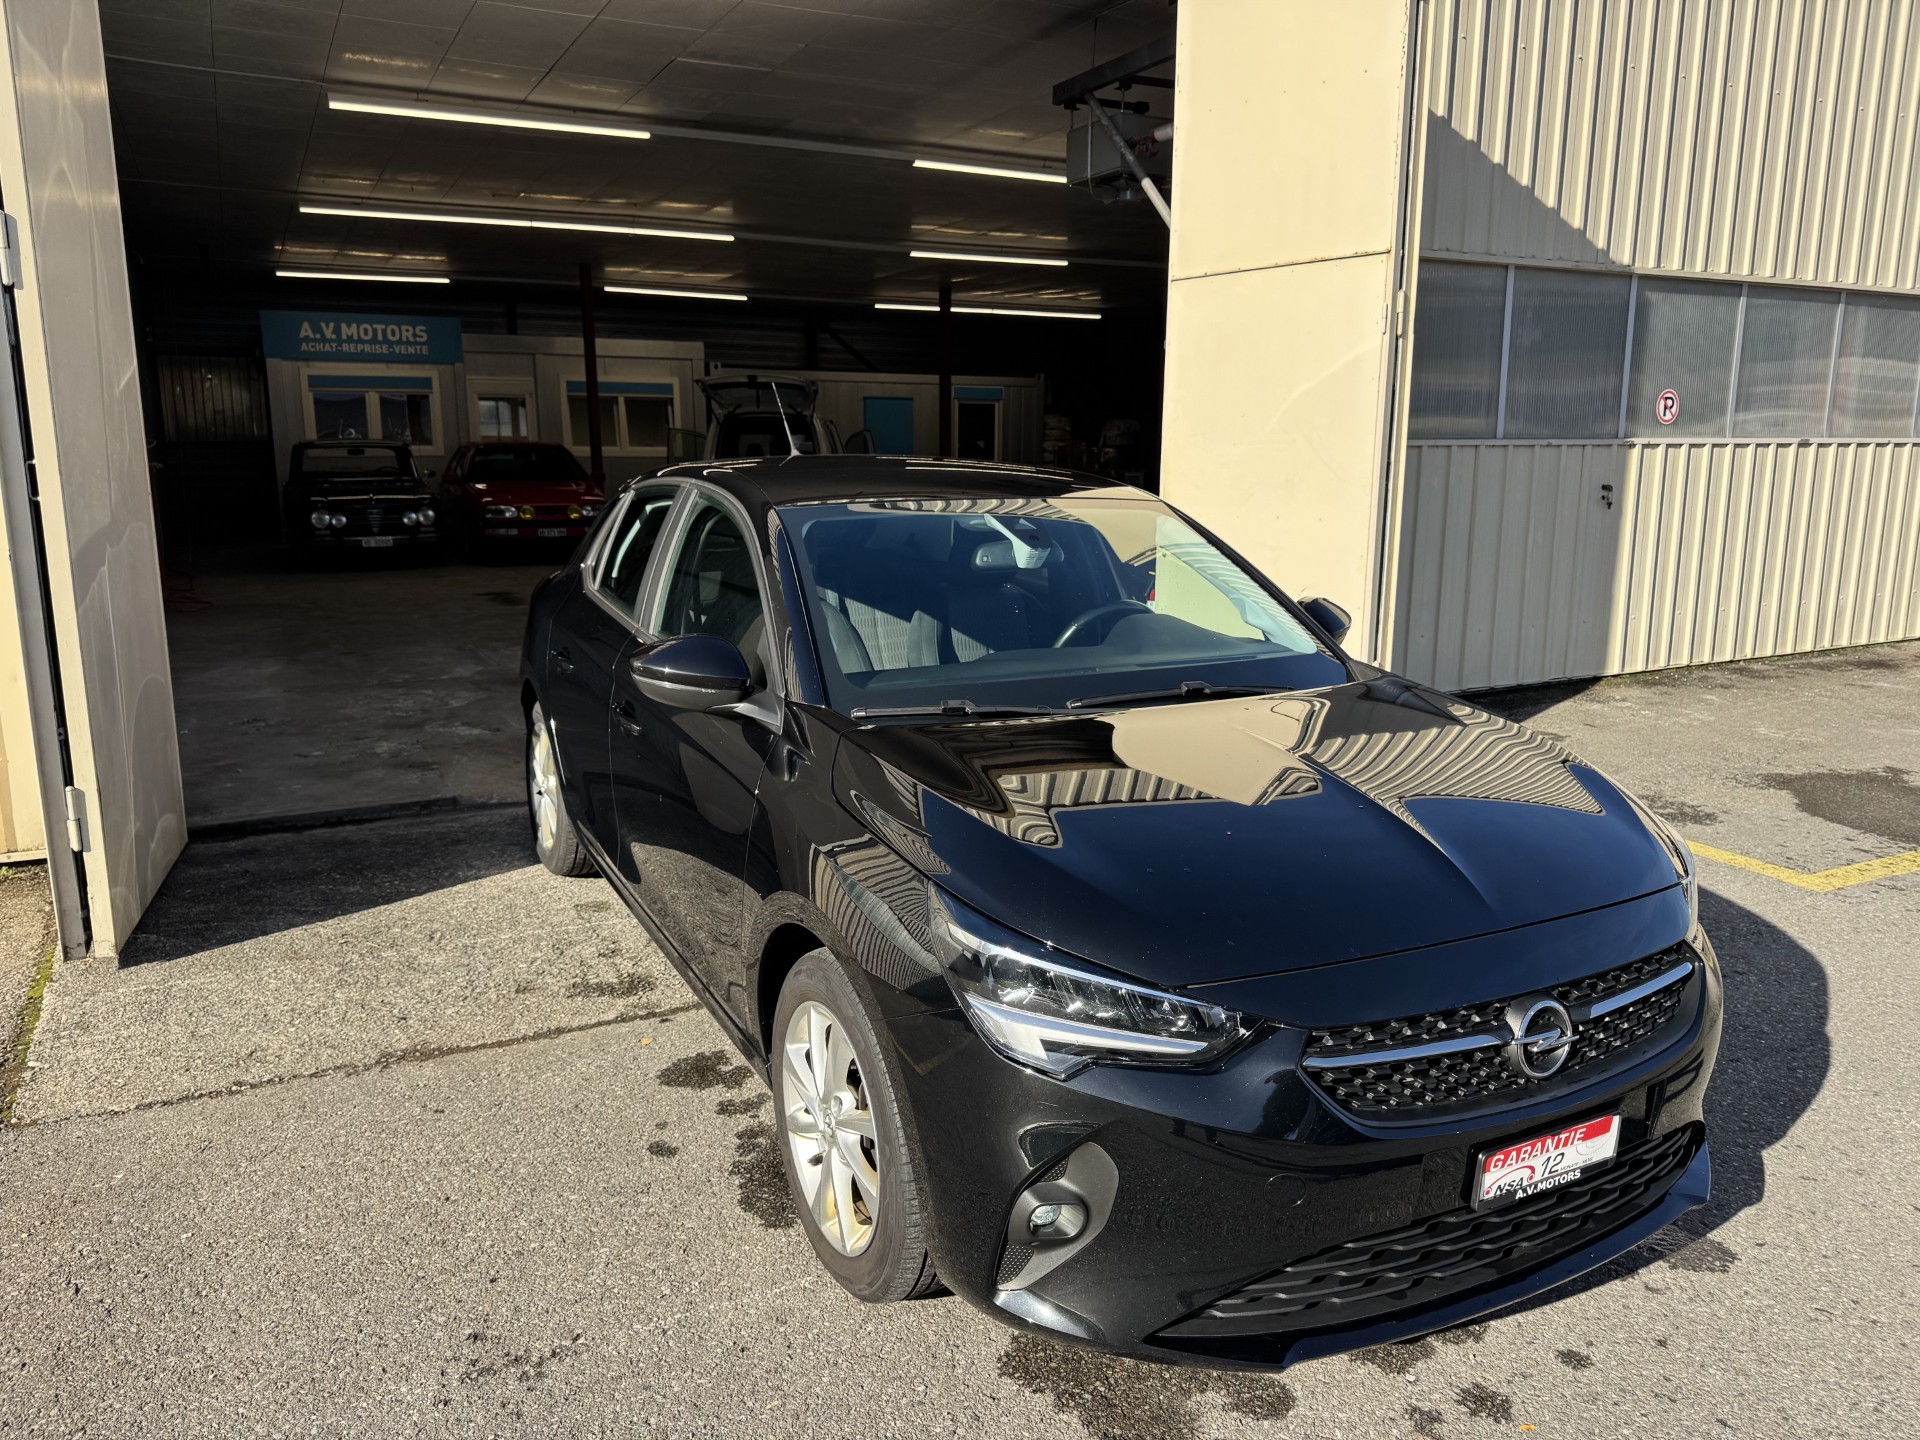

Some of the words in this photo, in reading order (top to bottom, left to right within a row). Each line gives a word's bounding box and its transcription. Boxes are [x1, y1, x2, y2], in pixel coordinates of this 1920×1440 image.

[301, 342, 429, 355] ACHAT-REPRISE-VENTE
[1663, 396, 1675, 417] P
[1490, 1128, 1587, 1172] GARANTIE
[1541, 1152, 1566, 1178] 12
[1494, 1176, 1525, 1197] NSA
